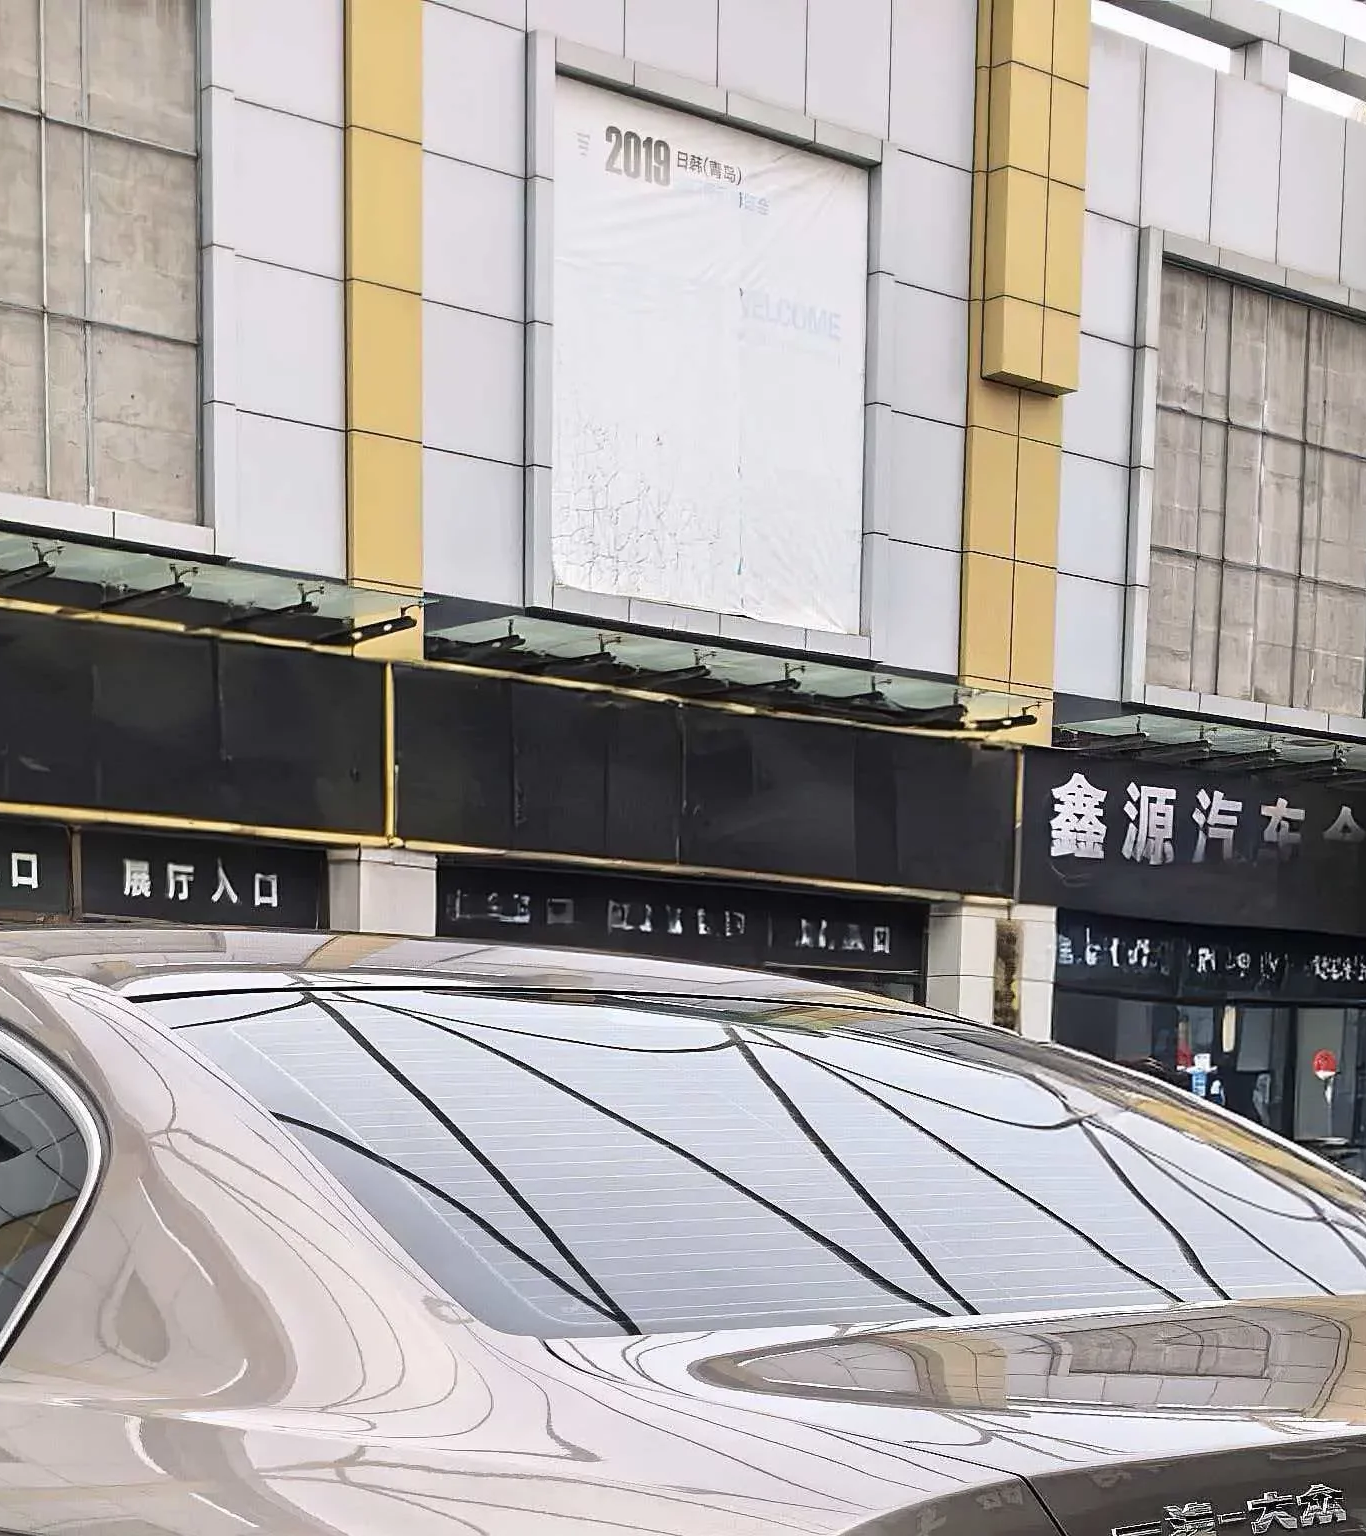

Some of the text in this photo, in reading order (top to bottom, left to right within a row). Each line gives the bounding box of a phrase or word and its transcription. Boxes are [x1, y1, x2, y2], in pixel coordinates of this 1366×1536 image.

[605, 125, 671, 187] 2019
[123, 858, 279, 907] 展厅入口
